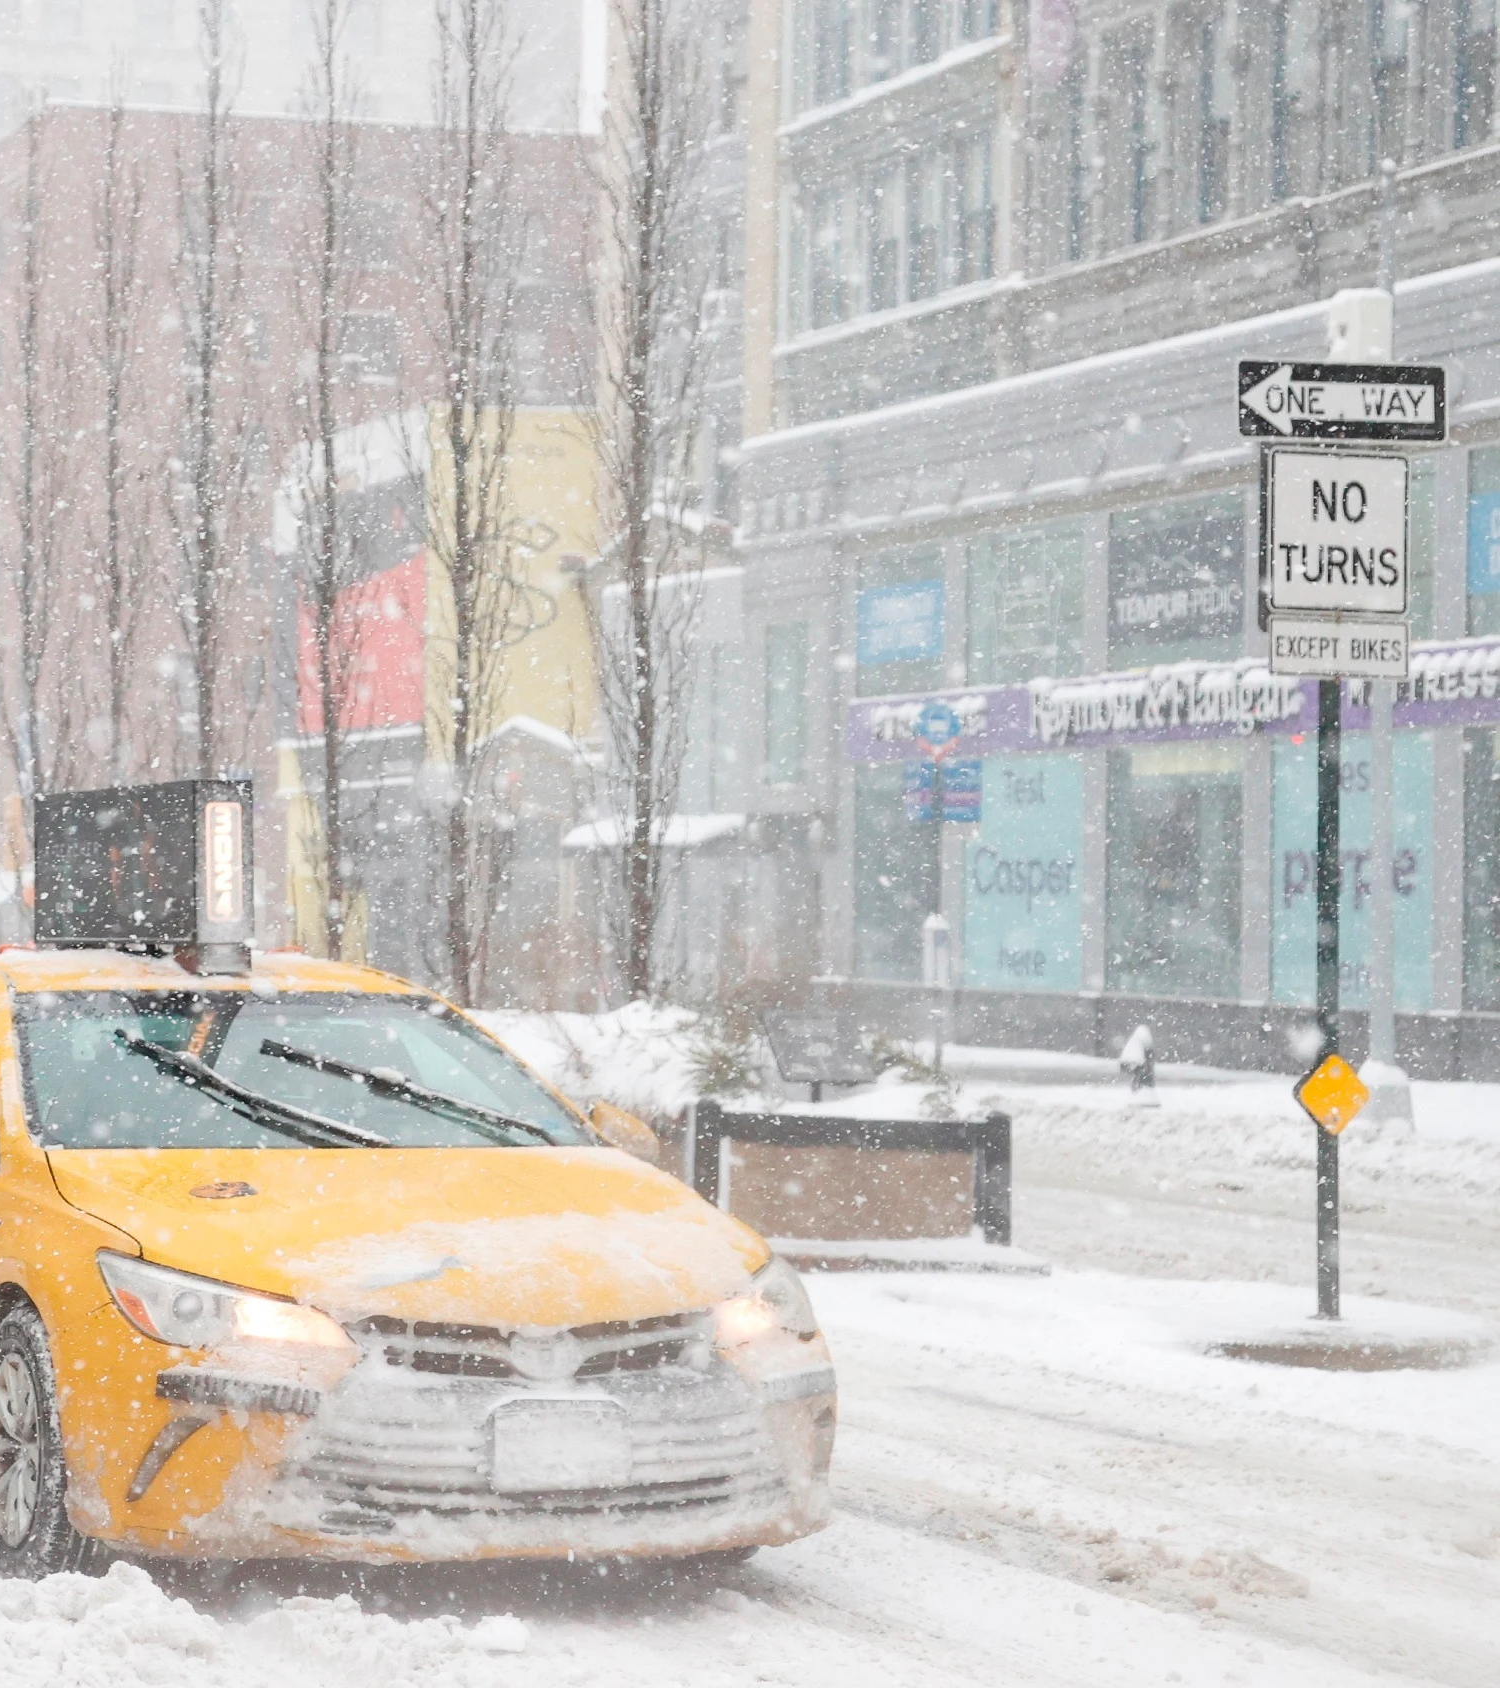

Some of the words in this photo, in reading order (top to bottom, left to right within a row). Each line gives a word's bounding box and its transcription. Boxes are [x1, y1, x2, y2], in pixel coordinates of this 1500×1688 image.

[1266, 384, 1325, 415] ONE
[1361, 387, 1427, 417] WAY
[1312, 480, 1367, 523] NO
[1279, 544, 1399, 586] TURNS
[1276, 635, 1339, 659] EXCEPT
[1351, 638, 1402, 661] BIKES
[973, 846, 1076, 914] Casper
